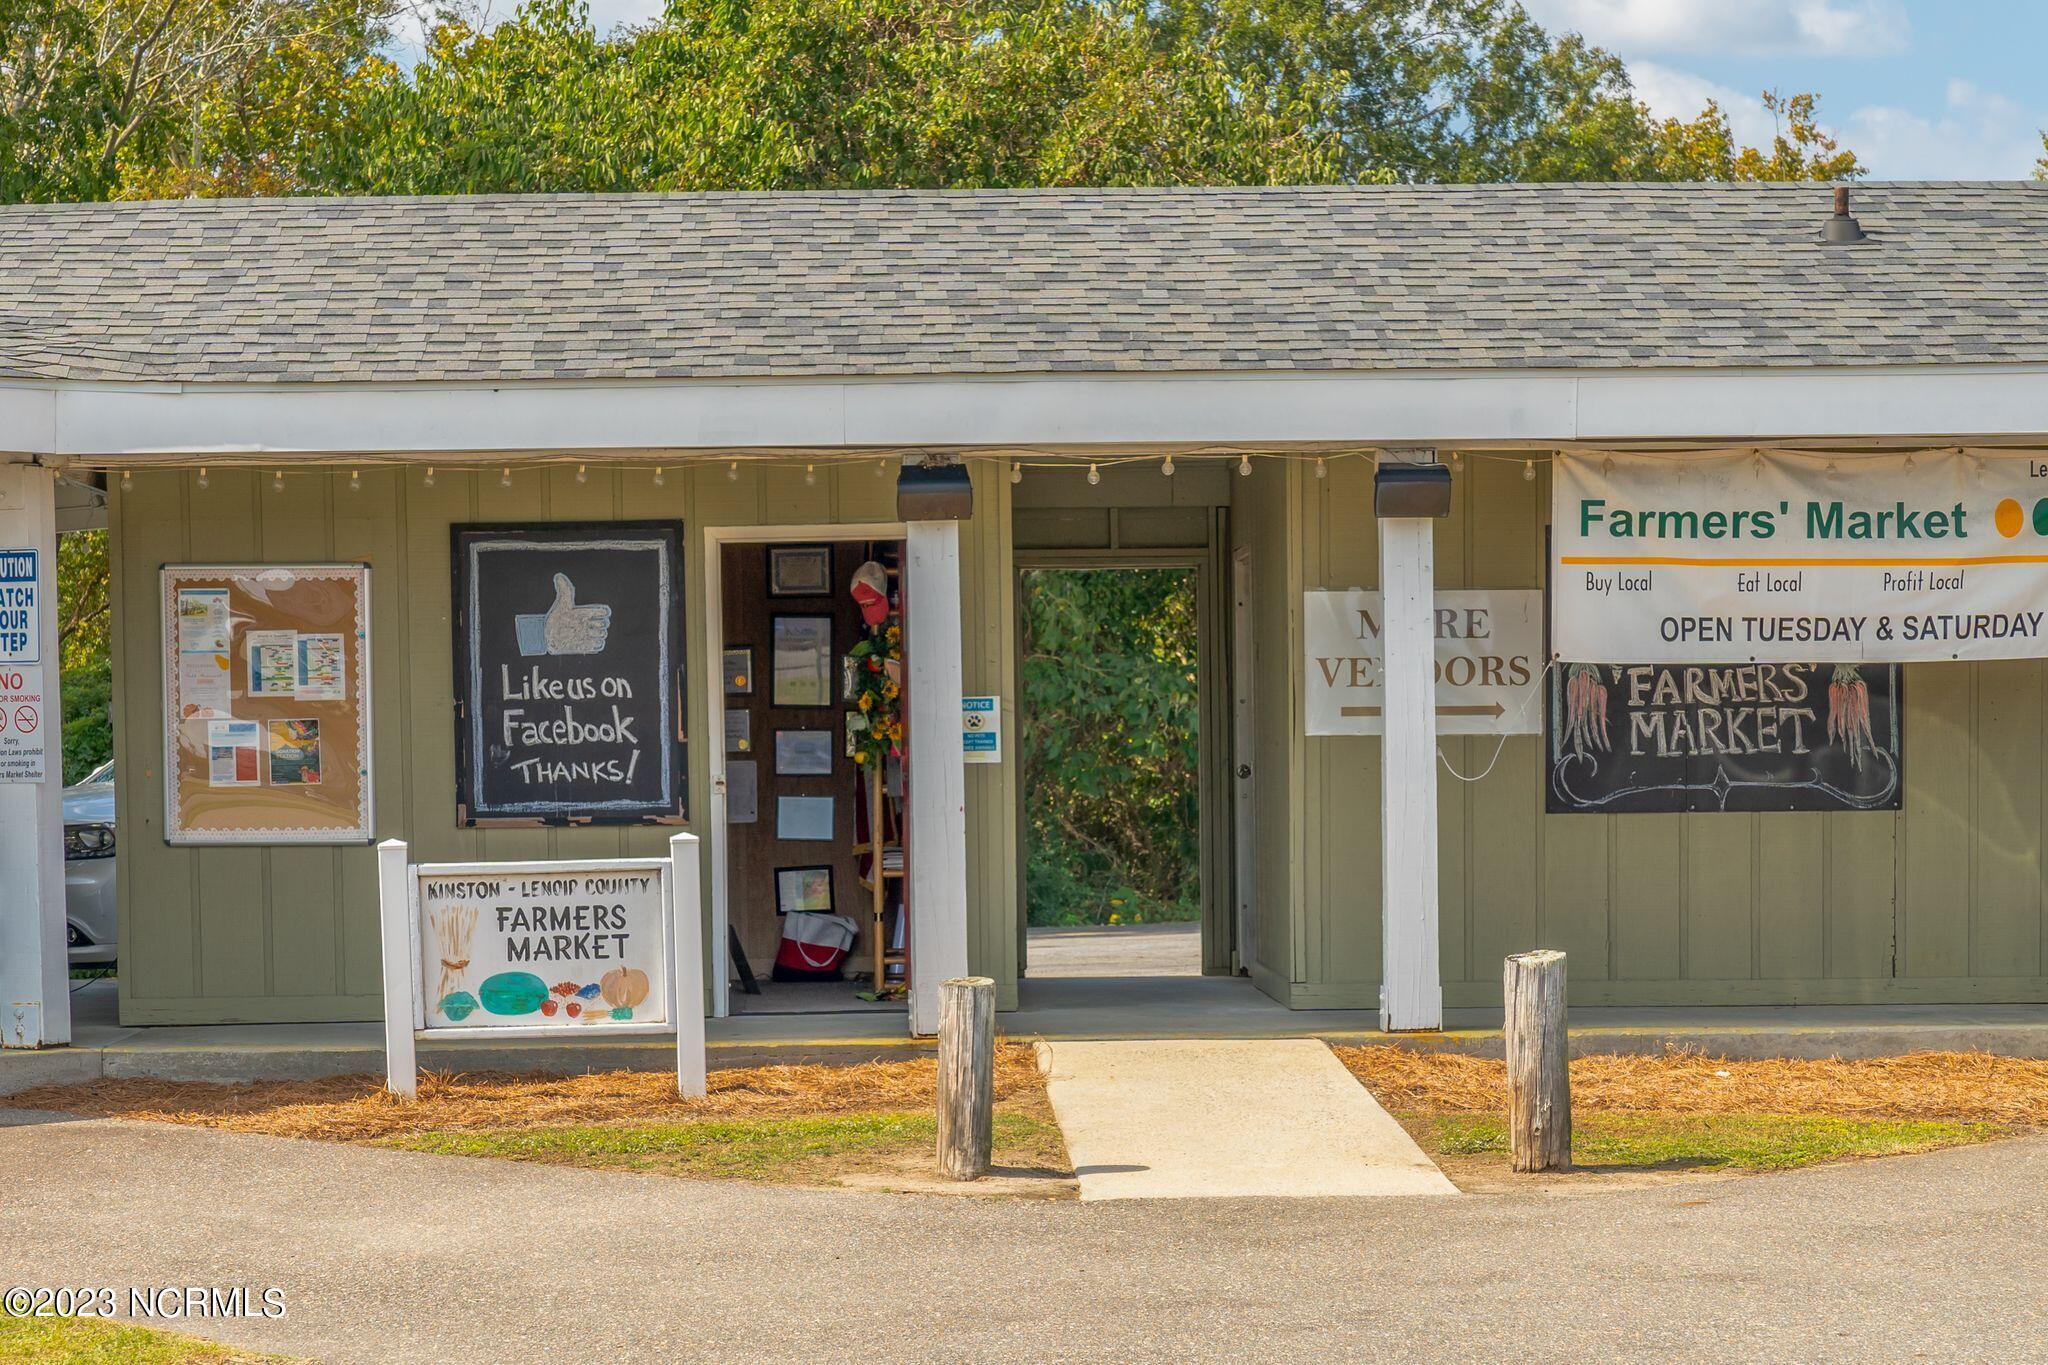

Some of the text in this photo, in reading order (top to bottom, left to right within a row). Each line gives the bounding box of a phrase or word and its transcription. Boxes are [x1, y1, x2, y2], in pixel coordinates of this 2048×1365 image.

[1580, 499, 1968, 539] Farmers' Market
[0, 557, 33, 578] UTION
[1883, 569, 1965, 591] Profit Local
[1586, 570, 1652, 596] Buy Local
[1737, 571, 1802, 592] Eat Local
[0, 587, 34, 607] ATCH
[0, 610, 28, 629] OUR
[1356, 608, 1491, 639] MRE
[1660, 612, 2044, 642] OPEN TUESDAY & SATURDAY
[0, 632, 28, 652] TEP
[501, 664, 633, 700] Like us on
[1316, 655, 1532, 688] VEORS
[1626, 663, 1810, 707] FARMERS
[10, 694, 41, 703] SMOKING
[503, 704, 639, 746] Facebook
[1628, 705, 1817, 758] MARKET
[7, 760, 30, 768] smoking
[23, 747, 43, 756] prohibit
[24, 770, 43, 778] Shelter
[510, 749, 640, 784] THANKS!
[427, 881, 500, 900] KINSTON
[585, 877, 650, 896] COUNTY
[495, 904, 627, 932] FARMERS
[507, 932, 630, 962] MARKET
